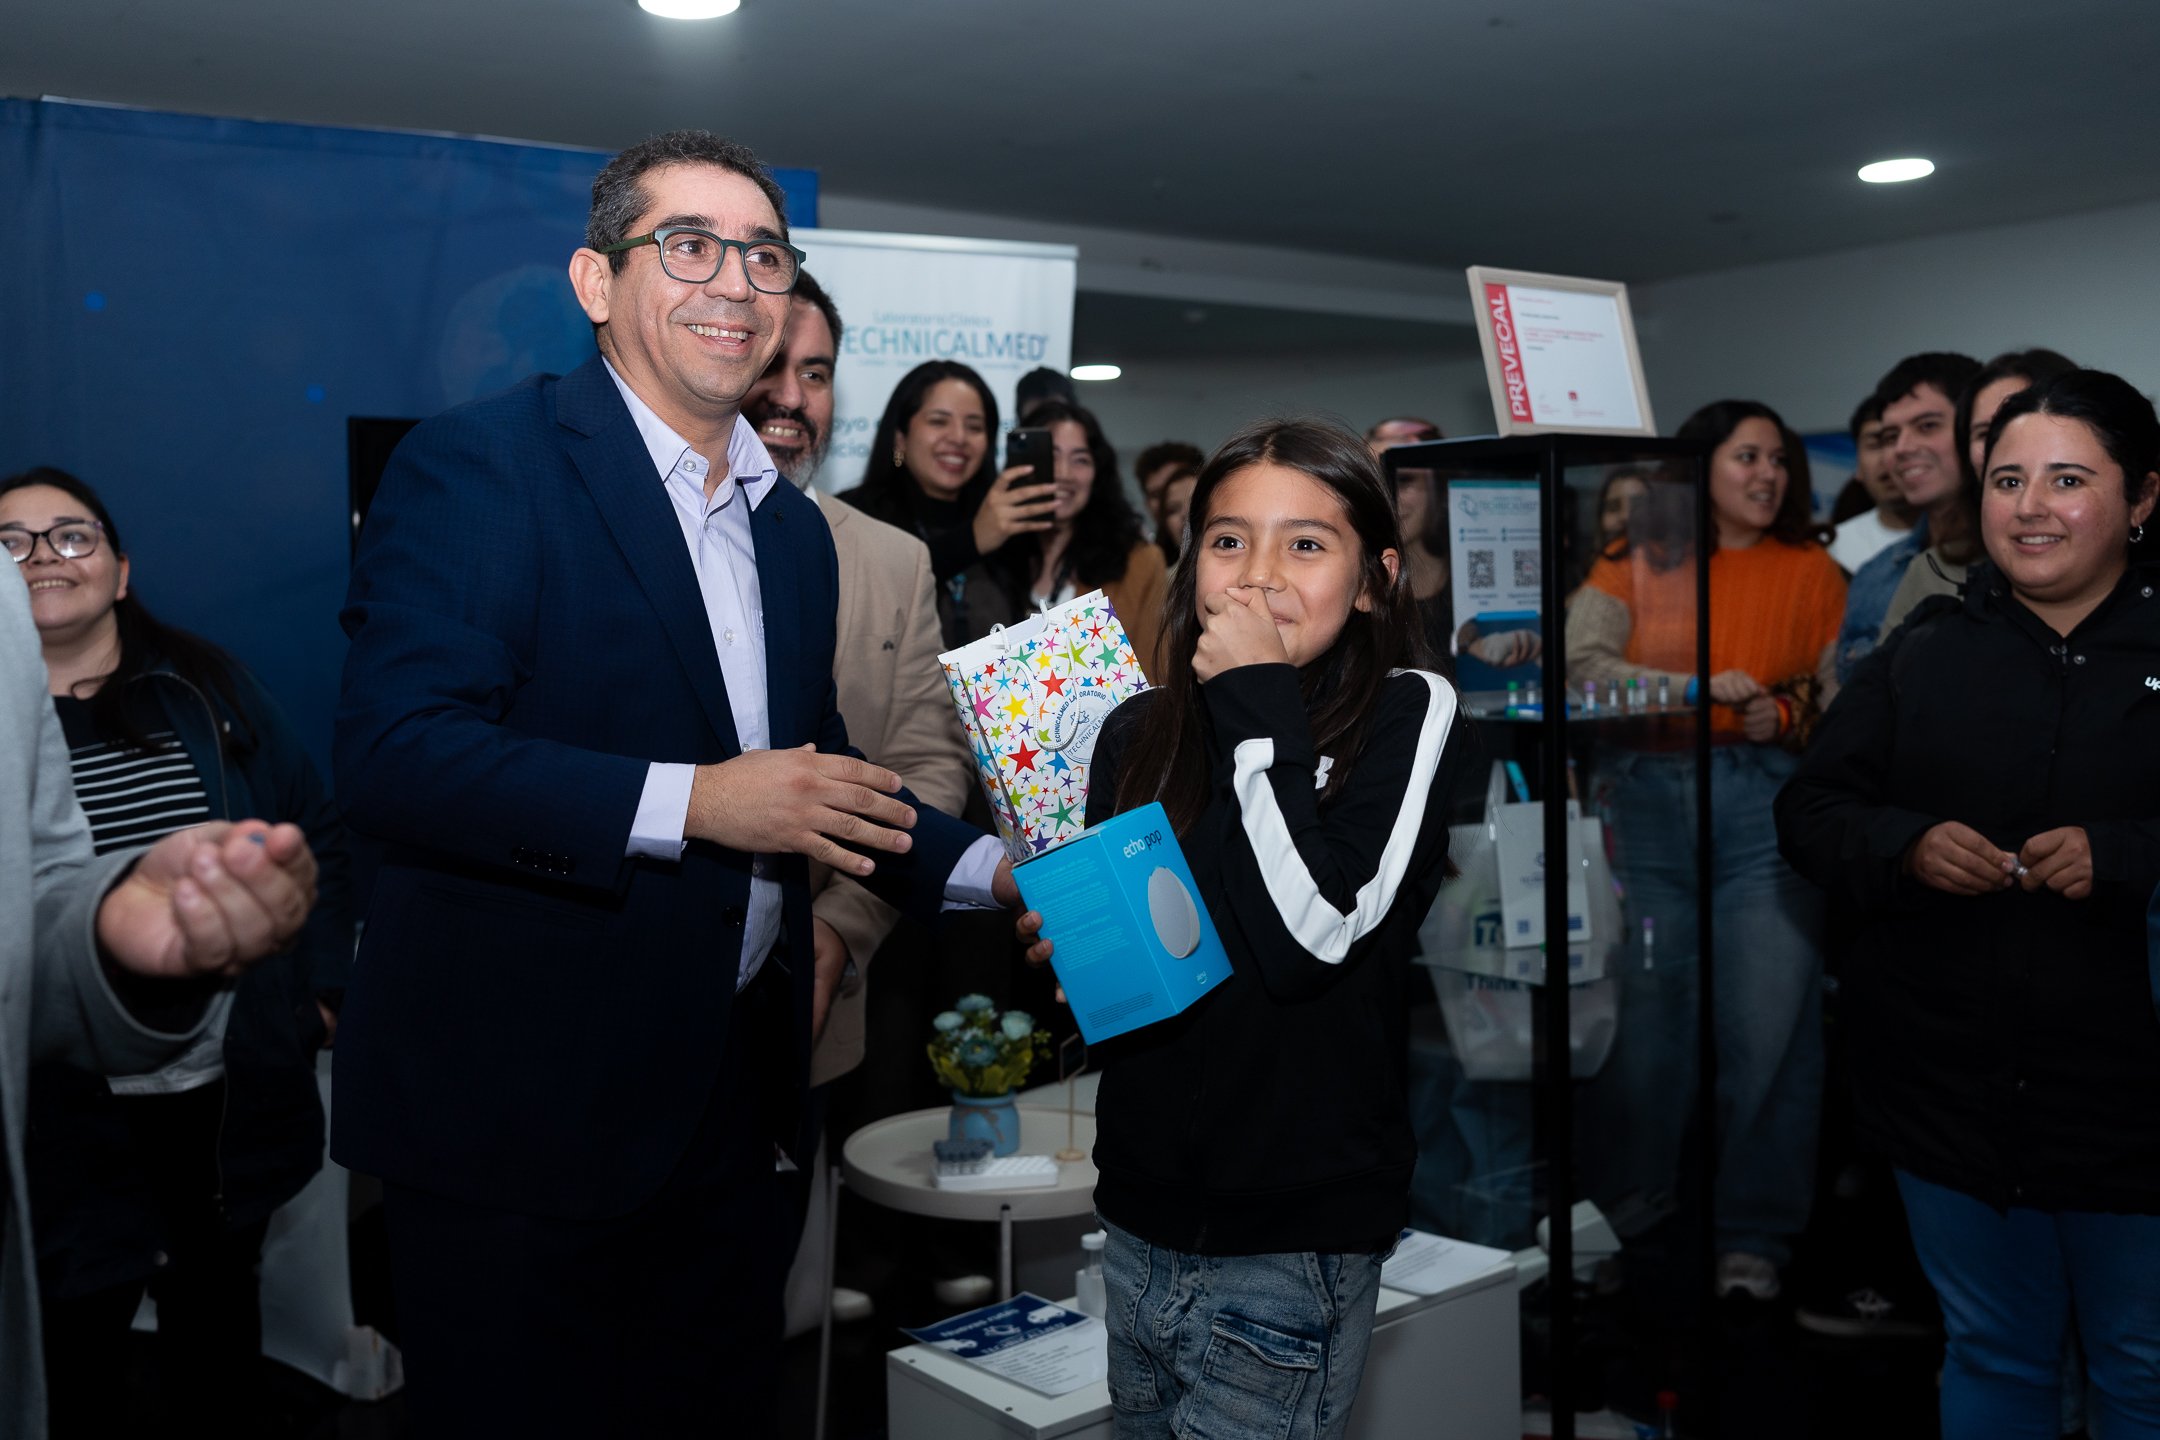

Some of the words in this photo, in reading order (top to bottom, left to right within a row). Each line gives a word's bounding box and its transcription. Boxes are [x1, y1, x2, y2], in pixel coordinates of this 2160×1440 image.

[842, 326, 1044, 361] ECHNICALMED
[1491, 294, 1527, 417] PREVECAL
[1054, 701, 1069, 743] ECHNICALMED
[1069, 690, 1107, 703] LAORATORIO
[1123, 838, 1146, 858] echo
[1144, 829, 1162, 851] pop
